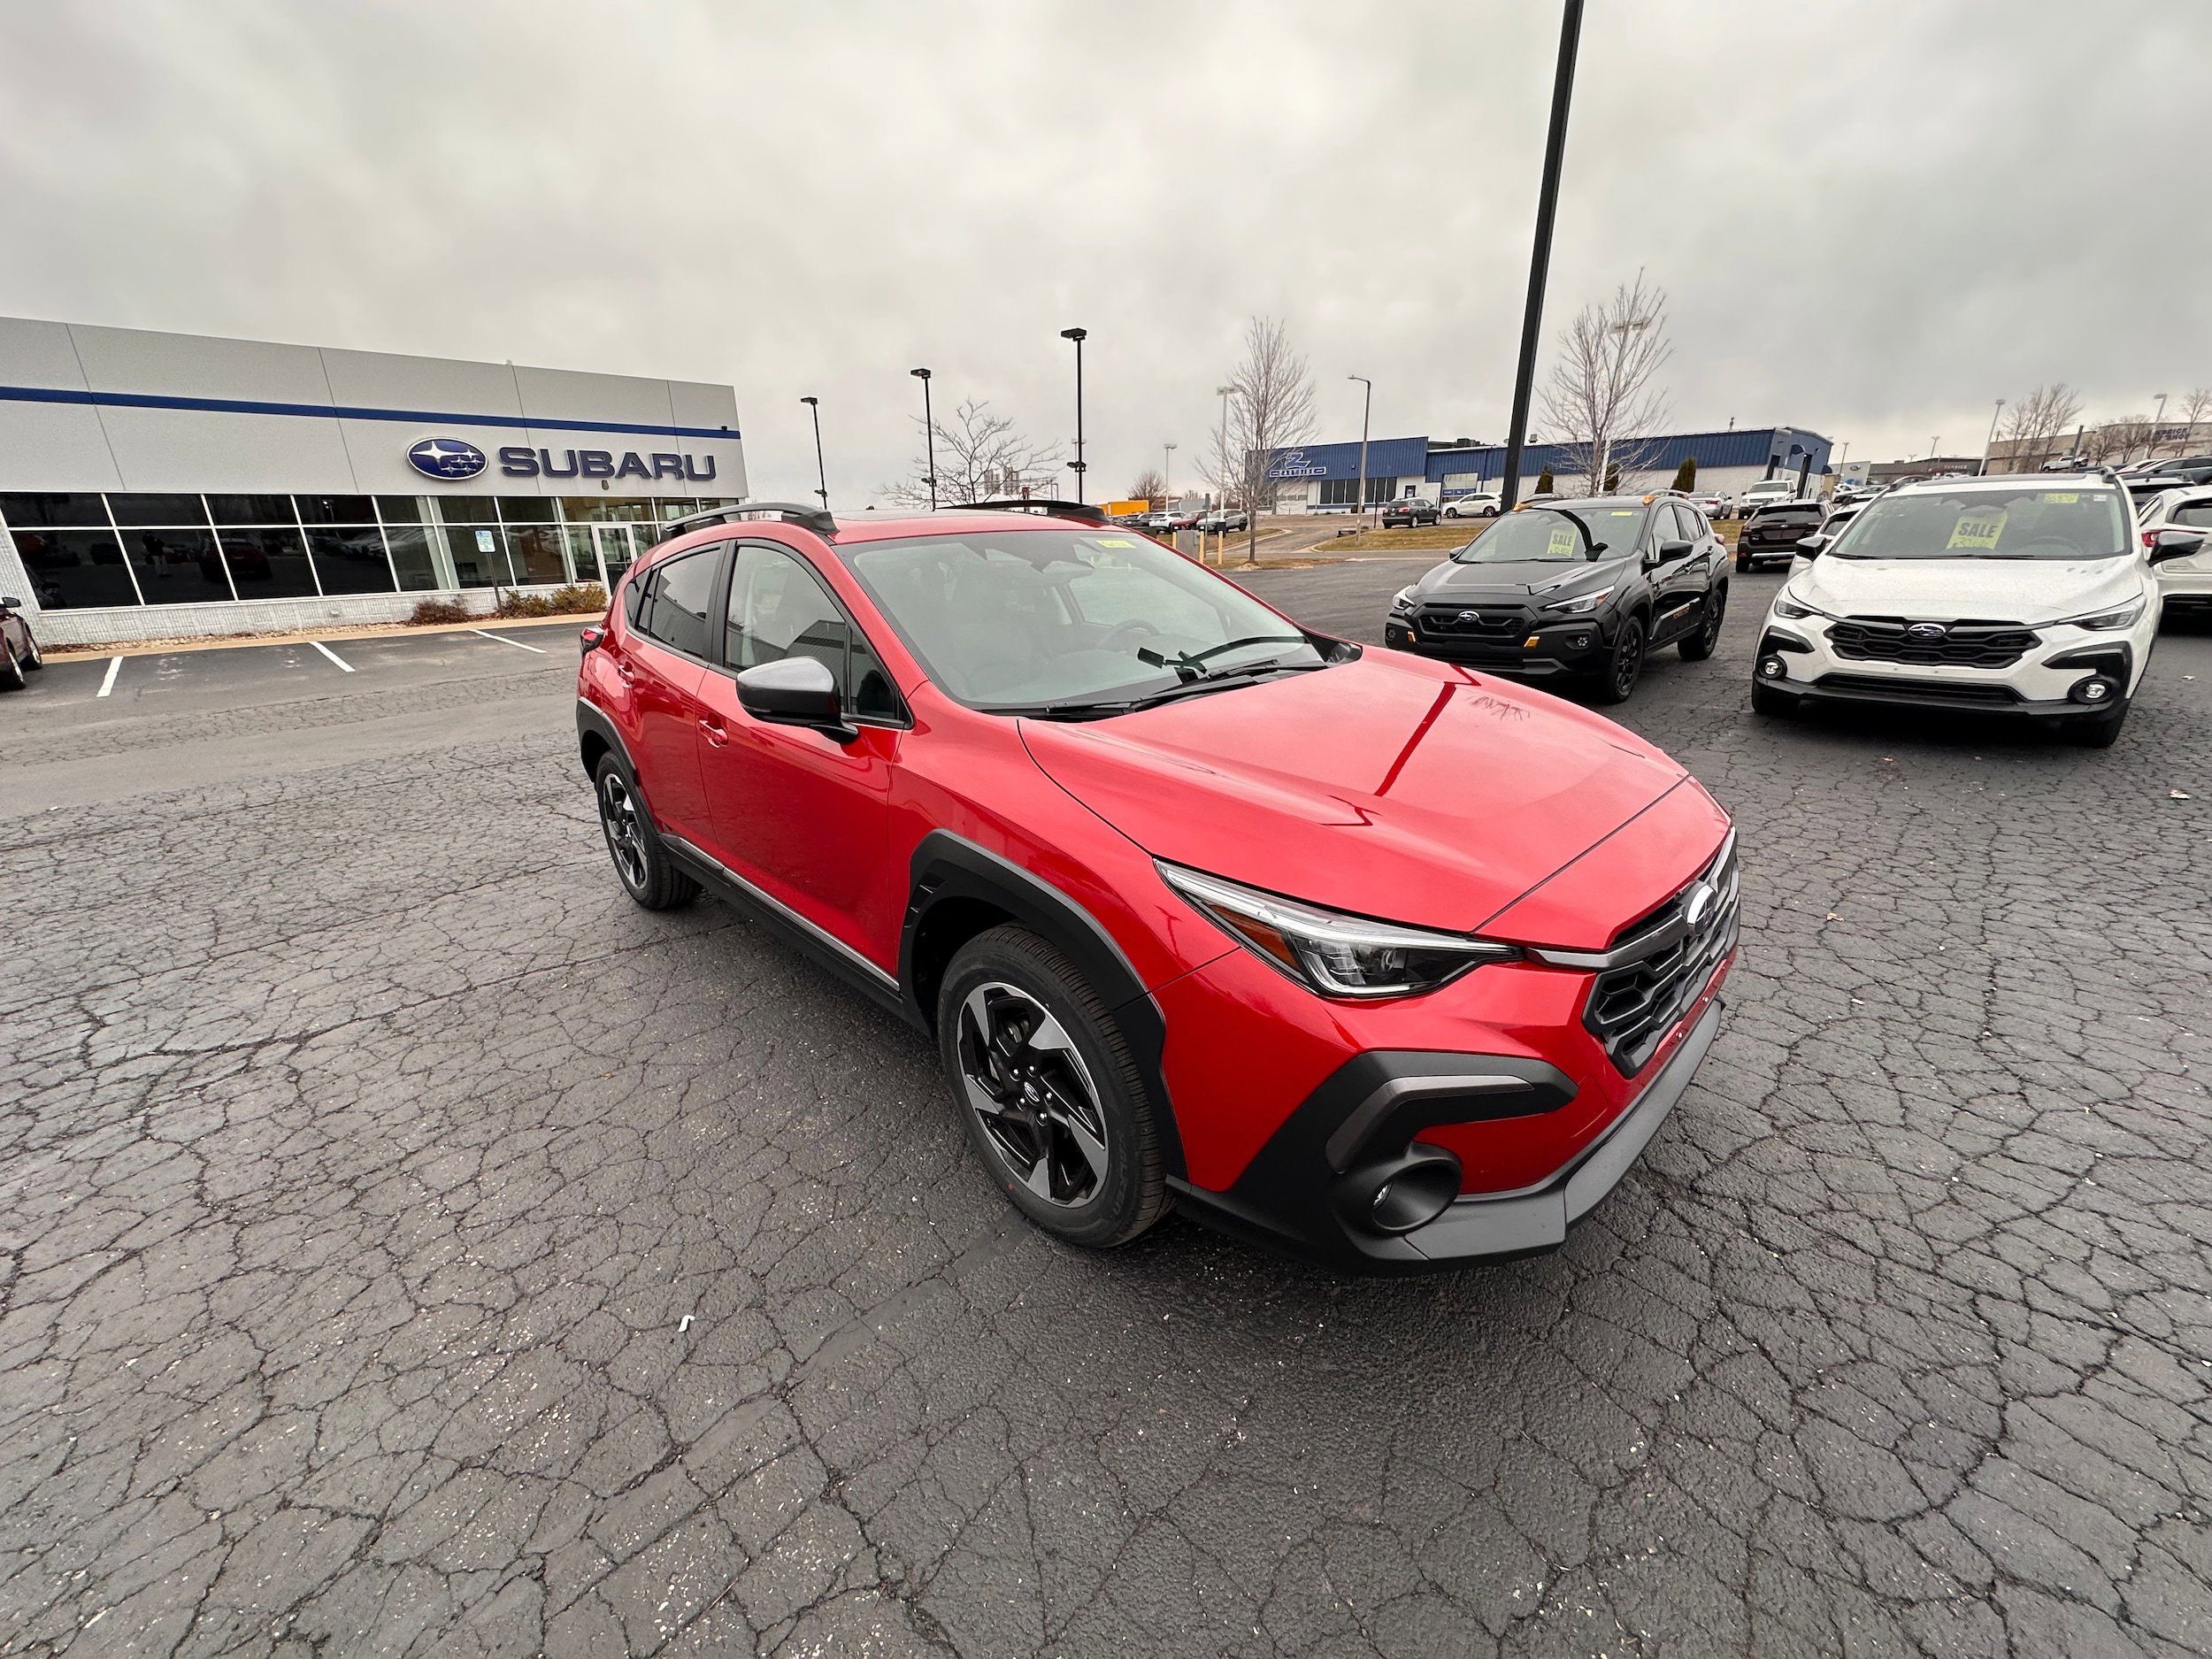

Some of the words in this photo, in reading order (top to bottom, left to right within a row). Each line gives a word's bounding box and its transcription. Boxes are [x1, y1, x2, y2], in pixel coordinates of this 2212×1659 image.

[498, 446, 718, 481] SUBARU
[1958, 523, 1998, 538] SALE
[1552, 534, 1572, 547] SALE
